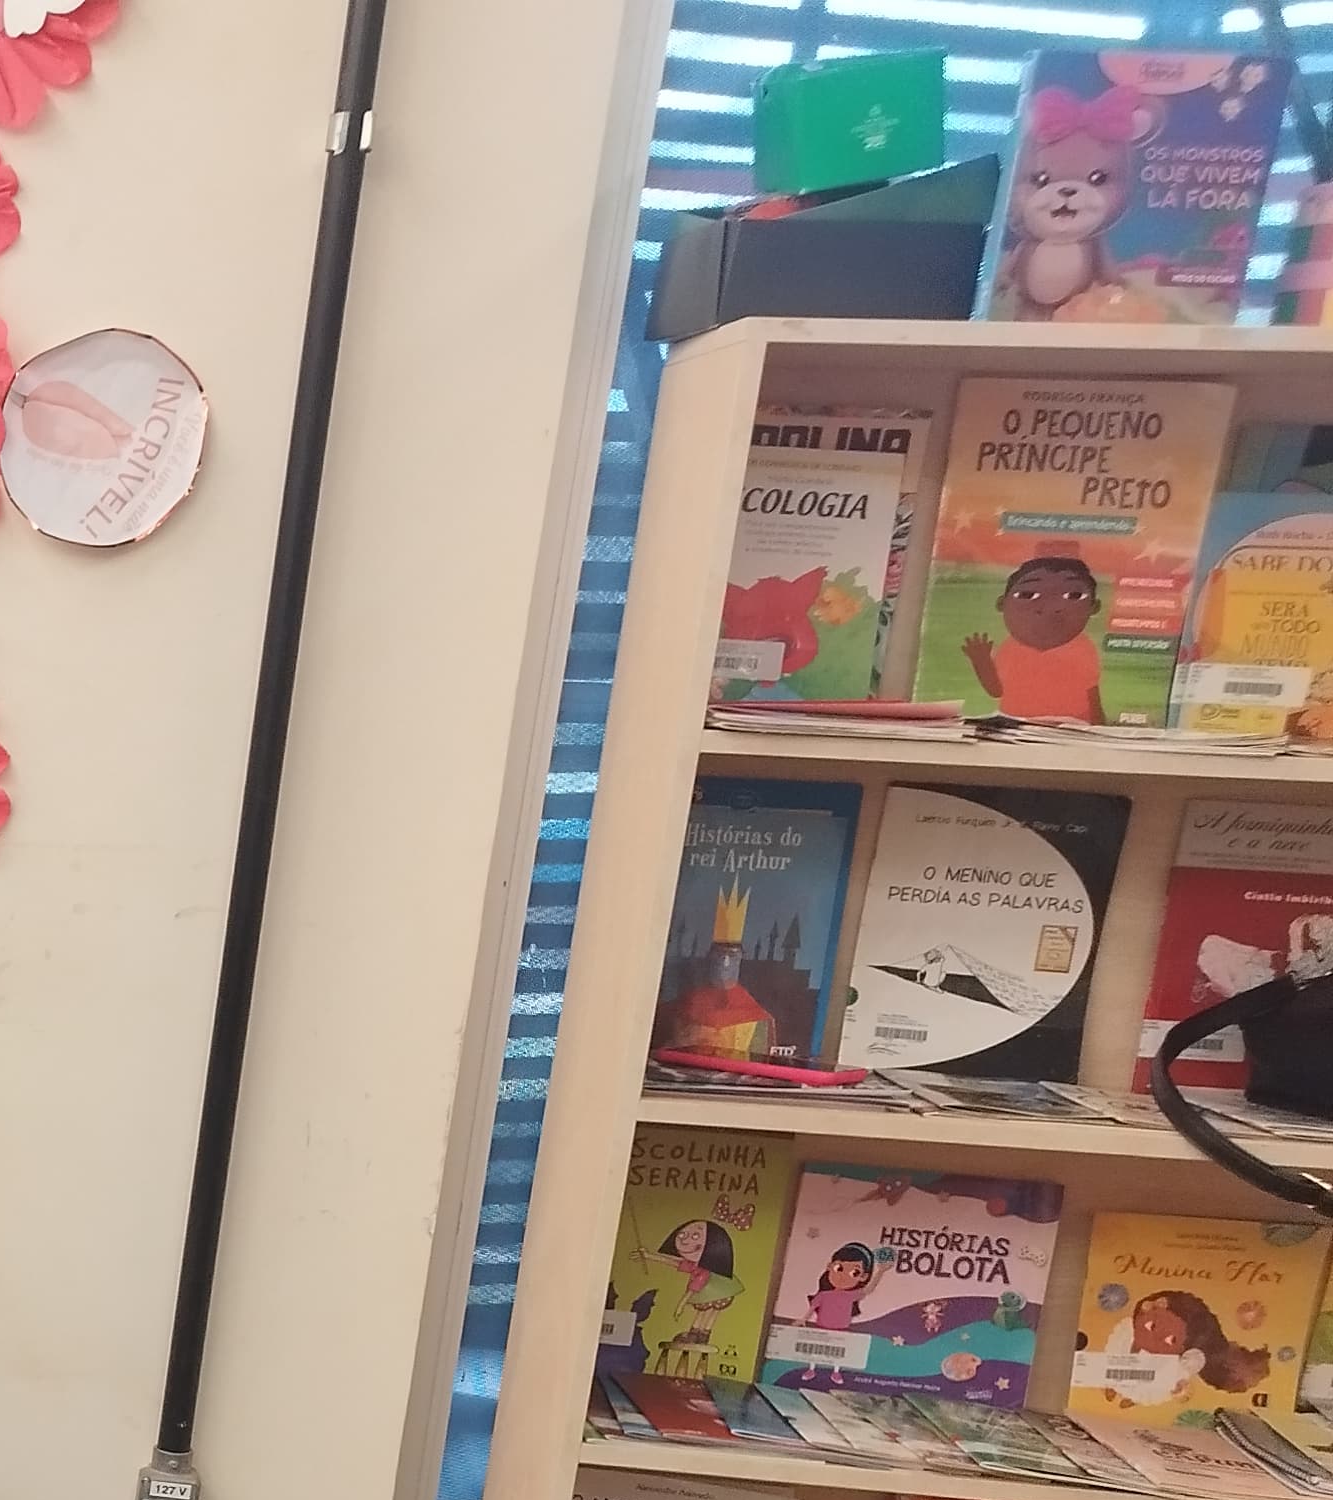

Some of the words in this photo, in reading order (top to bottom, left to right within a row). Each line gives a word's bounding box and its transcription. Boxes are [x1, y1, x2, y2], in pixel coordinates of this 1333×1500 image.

[1145, 147, 1169, 162] OS
[1172, 147, 1265, 163] MONSTROS
[1141, 164, 1190, 184] QUE
[1194, 167, 1262, 185] VIVEM
[1185, 188, 1252, 211] FORA
[1003, 408, 1021, 435] O
[1030, 409, 1163, 441] PEQUENO
[79, 377, 185, 540] INCRÍVEL!
[976, 434, 1113, 474] PRÍNCIPE
[741, 487, 870, 520] COLOGIA
[1080, 476, 1172, 510] PRETO
[684, 823, 773, 847] Histórias
[780, 826, 802, 846] do
[689, 848, 717, 867] rei
[723, 849, 791, 873] Arthur
[923, 866, 936, 880] O
[1019, 872, 1059, 888] QUE
[957, 892, 982, 906] AS
[987, 892, 1084, 914] PALAVRAS
[628, 1164, 759, 1196] SERAFINA
[880, 1225, 1010, 1257] HISTÓRIAS
[895, 1249, 1010, 1285] BOLOTA
[1113, 1252, 1213, 1281] Menina
[1226, 1260, 1285, 1286] Flor
[155, 1484, 175, 1496] 127
[179, 1487, 187, 1496] V
